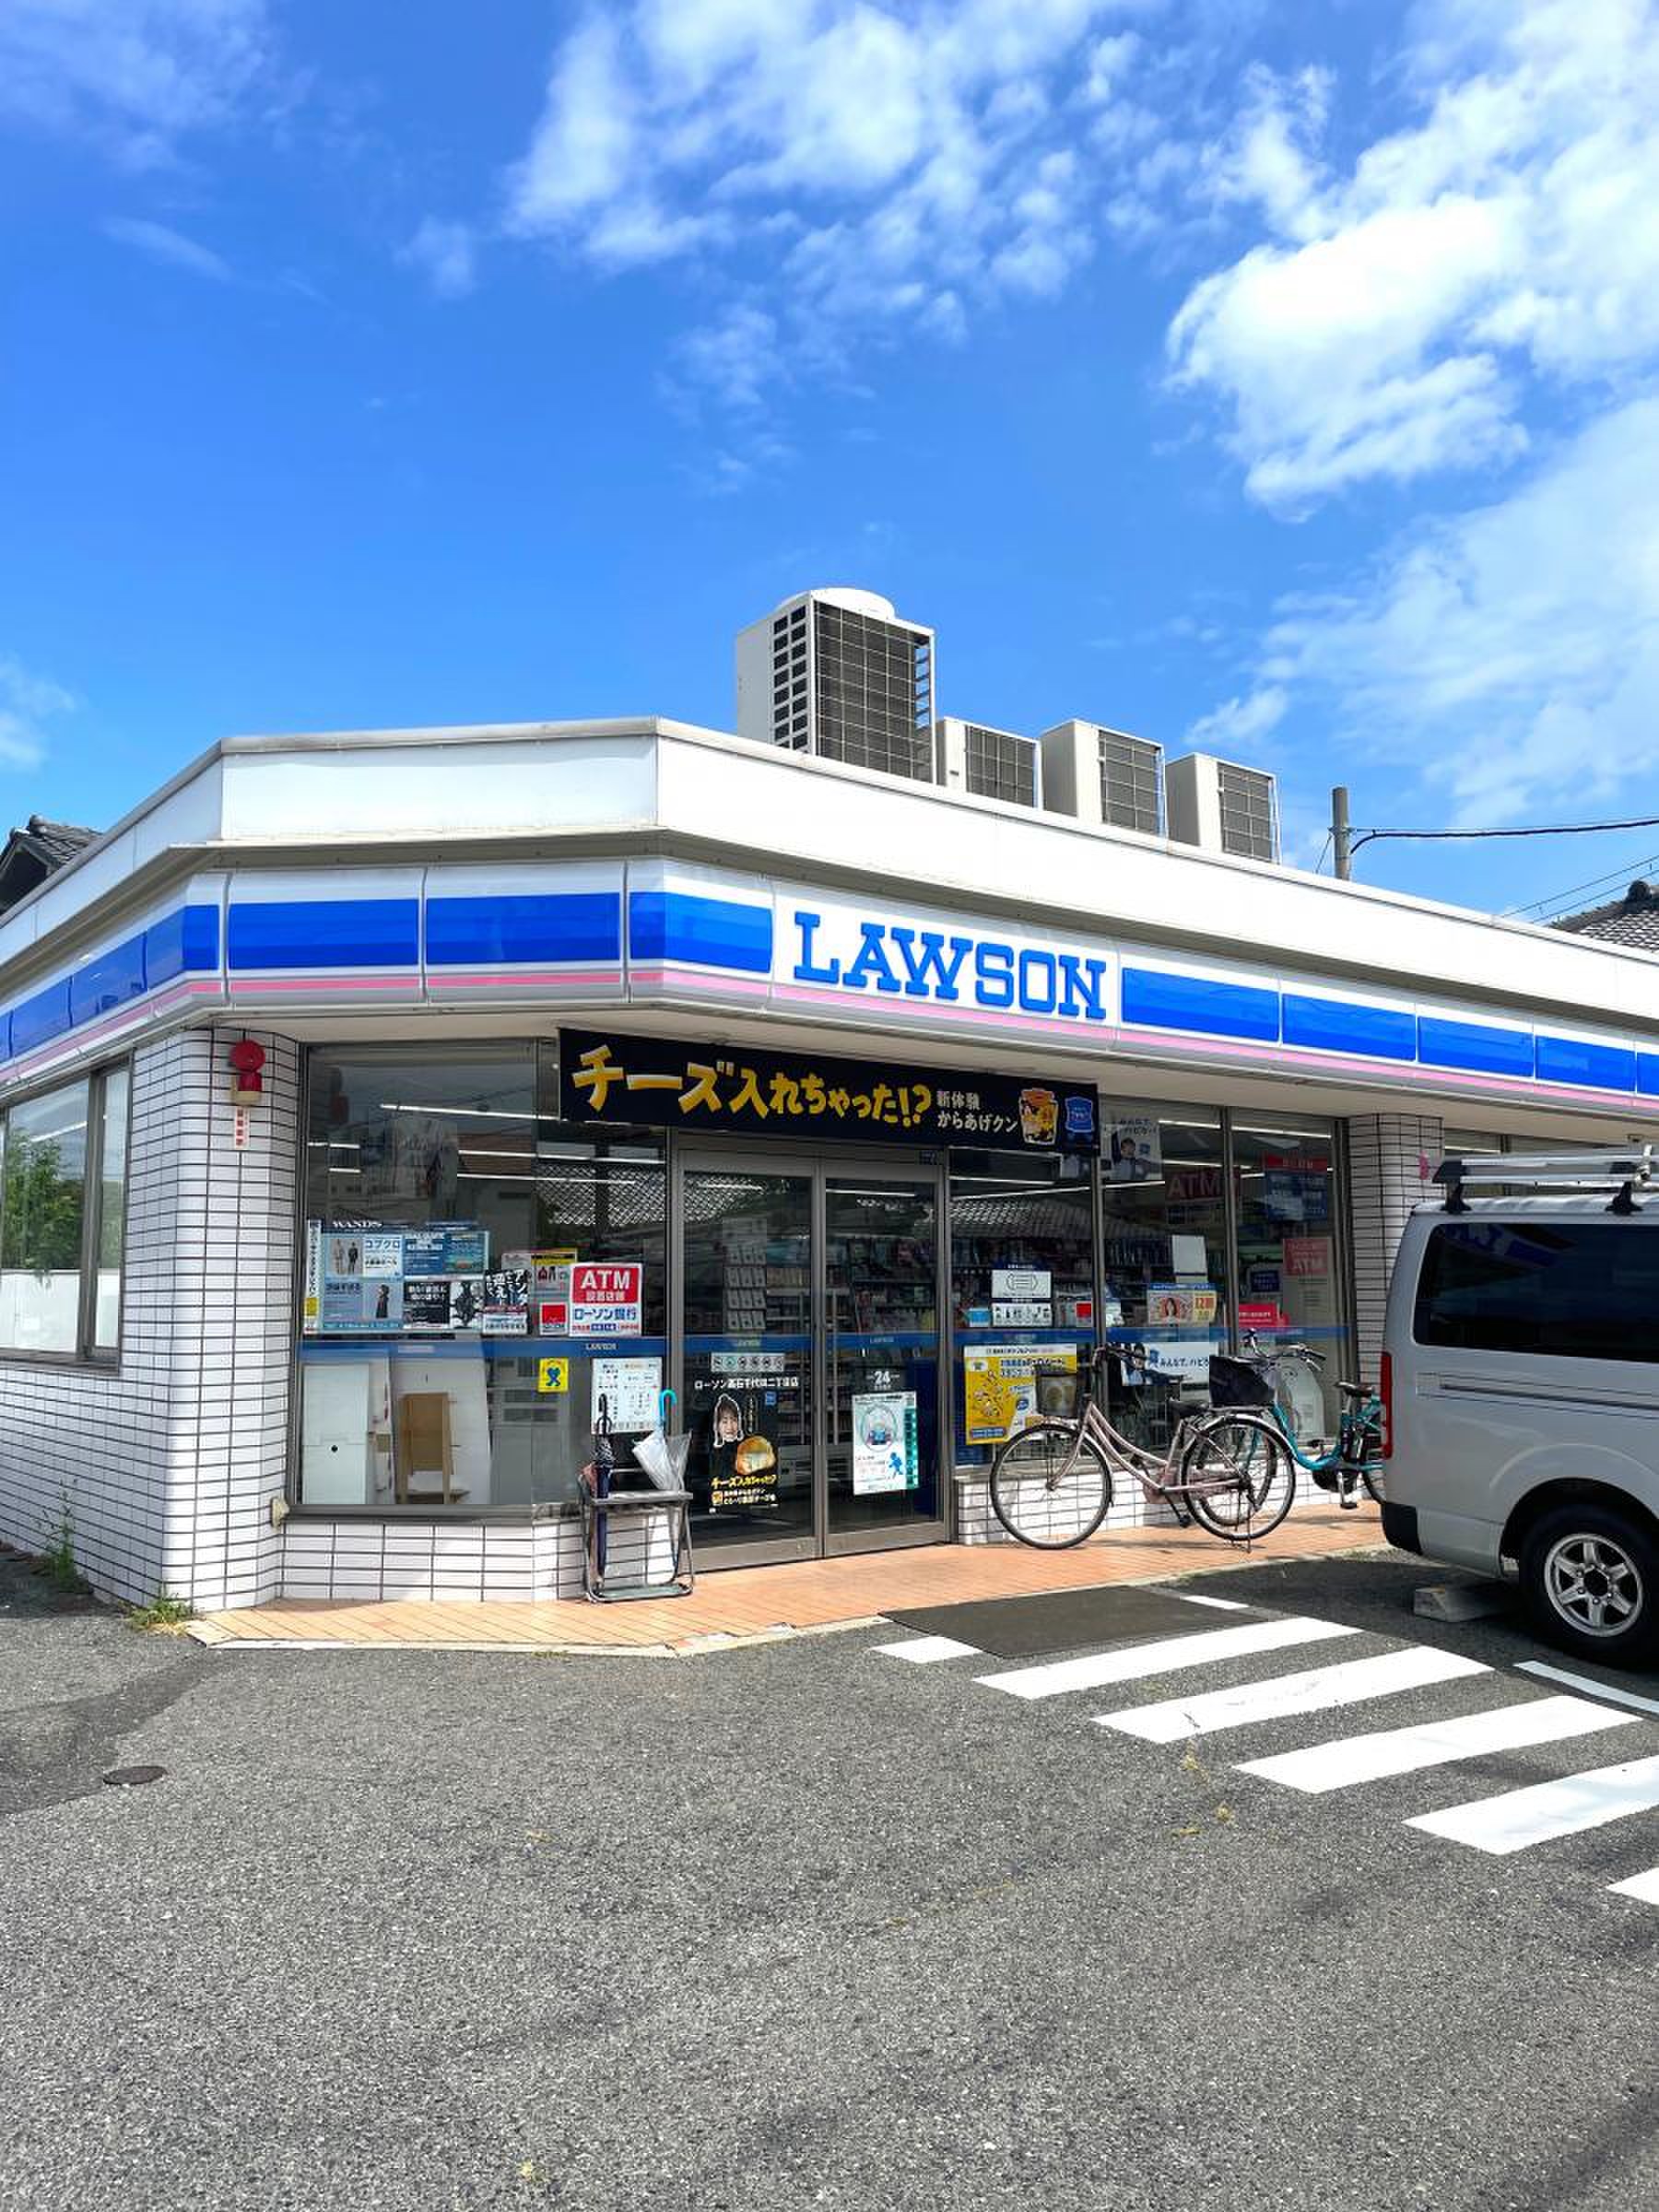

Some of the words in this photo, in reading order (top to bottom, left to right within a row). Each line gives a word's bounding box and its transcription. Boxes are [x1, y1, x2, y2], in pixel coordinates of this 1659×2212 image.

[793, 911, 1107, 1020] LAWSON
[571, 1043, 931, 1126] チーズ入れちゃった!?
[935, 1089, 982, 1112] 新体験
[935, 1109, 1019, 1135] からあげクン
[364, 1239, 400, 1250] コブクロ
[581, 1269, 631, 1290] ATM
[573, 1307, 638, 1322] ローソン銀行
[874, 1371, 890, 1385] 24
